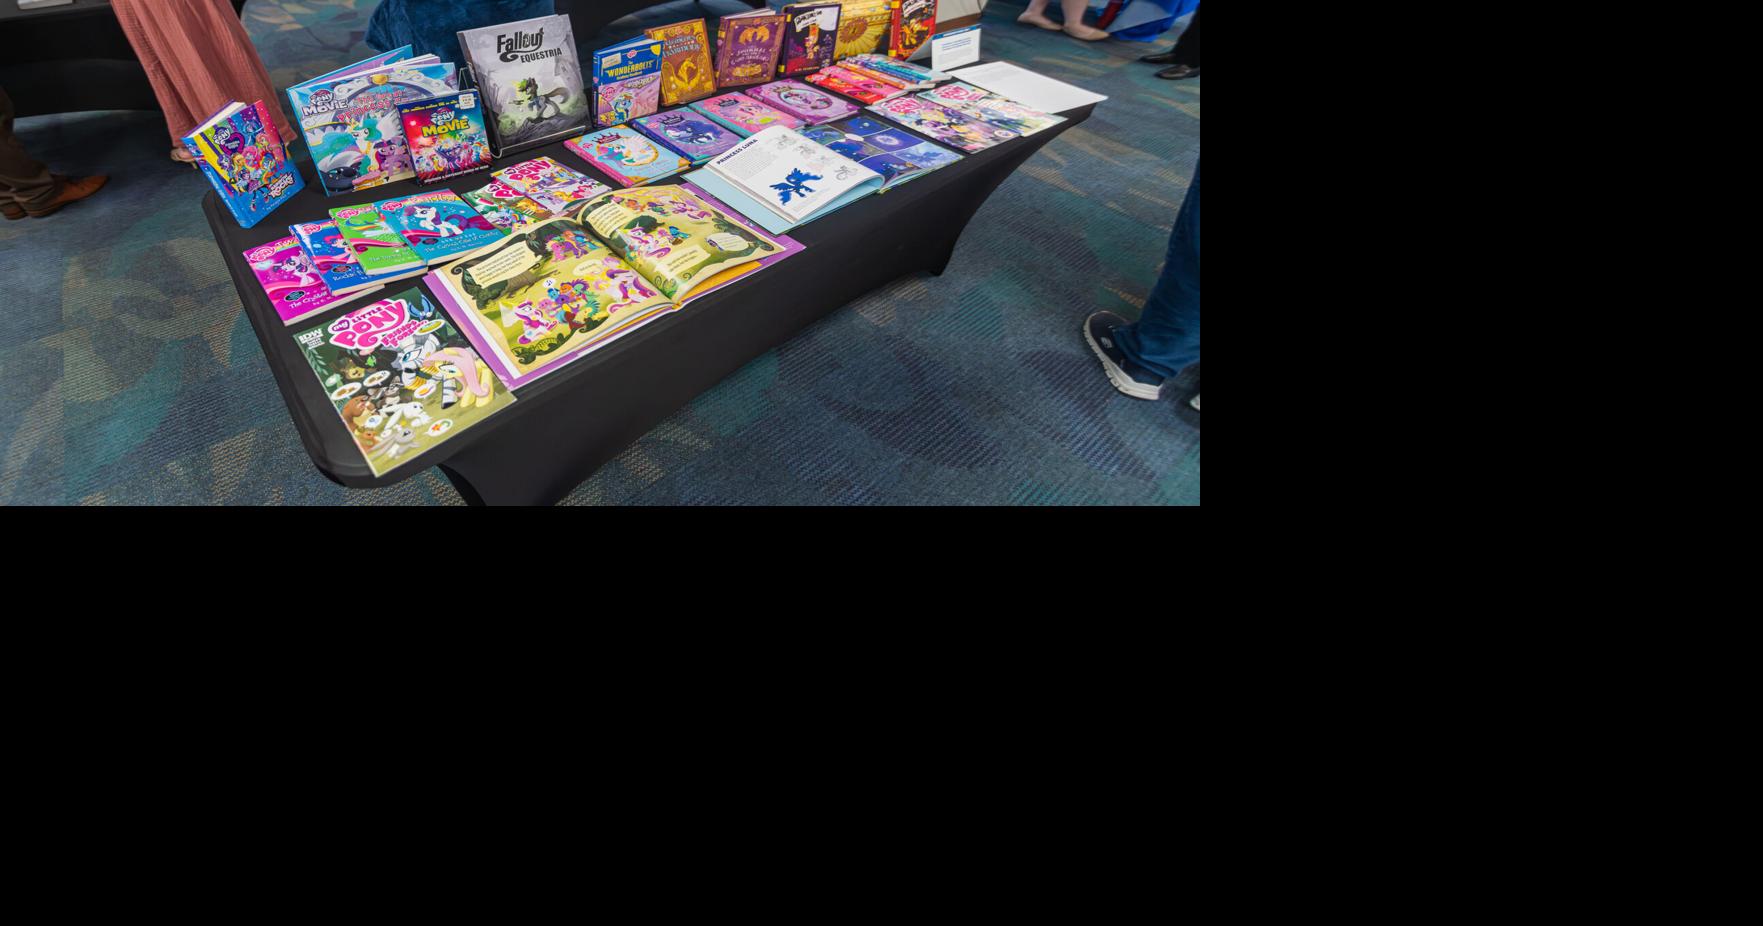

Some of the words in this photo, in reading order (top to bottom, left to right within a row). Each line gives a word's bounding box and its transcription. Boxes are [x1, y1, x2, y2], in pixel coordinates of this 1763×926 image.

[497, 28, 544, 58] Fallout
[521, 47, 562, 63] EQUESTRIA
[302, 100, 348, 116] MOVIE
[422, 118, 470, 137] MOVIE
[717, 144, 744, 164] PRINCESS
[743, 138, 758, 149] LUNA
[509, 160, 551, 180] PONY
[269, 175, 295, 198] ROCKS
[333, 301, 406, 347] PONY
[352, 306, 383, 324] LITTLE
[298, 328, 324, 344] IDW
